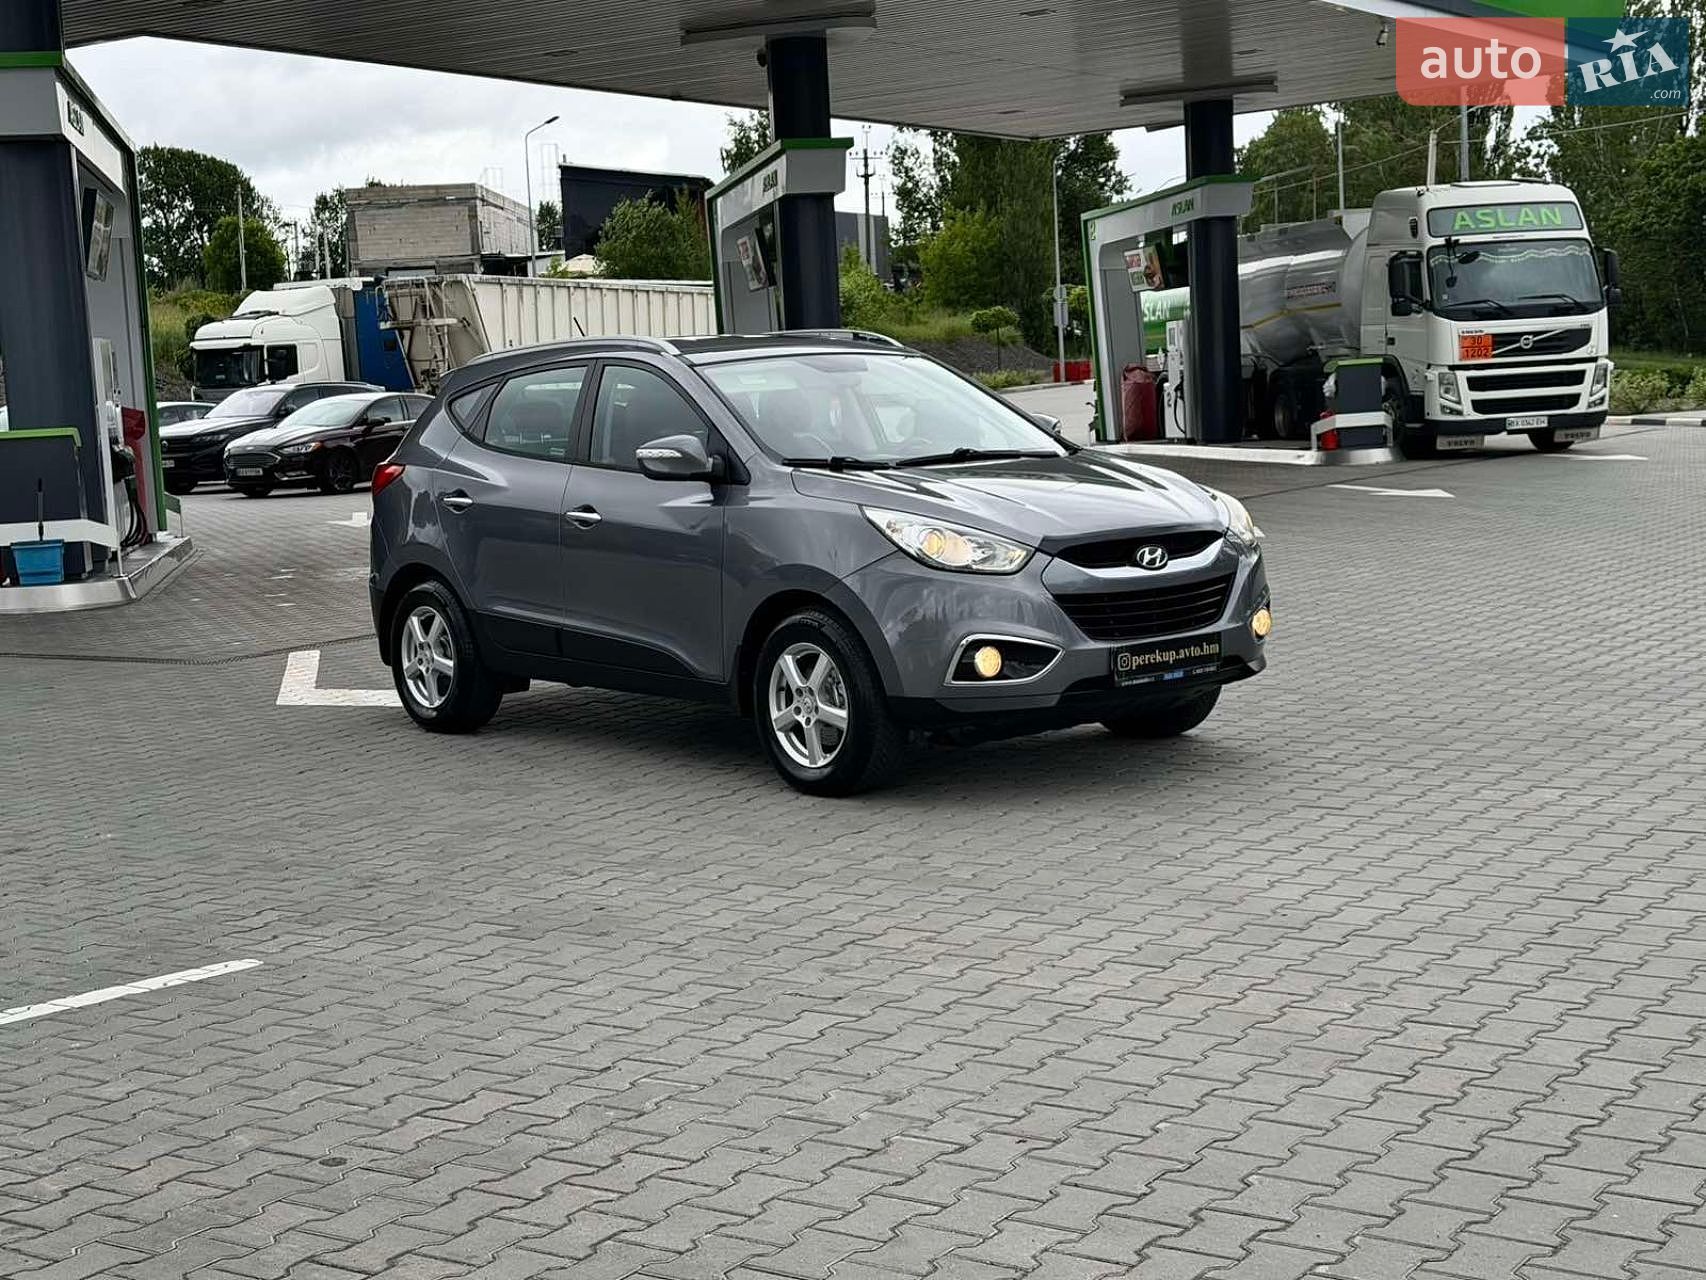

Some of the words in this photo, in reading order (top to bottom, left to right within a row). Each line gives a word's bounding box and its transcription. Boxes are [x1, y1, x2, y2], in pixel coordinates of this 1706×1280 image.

[1172, 198, 1194, 215] ASLAN
[1453, 207, 1562, 230] ASLAN
[1143, 302, 1170, 321] SLAN
[1470, 336, 1483, 346] 30
[1465, 348, 1489, 358] 1202
[1131, 642, 1219, 670] perekup.avto.hm
